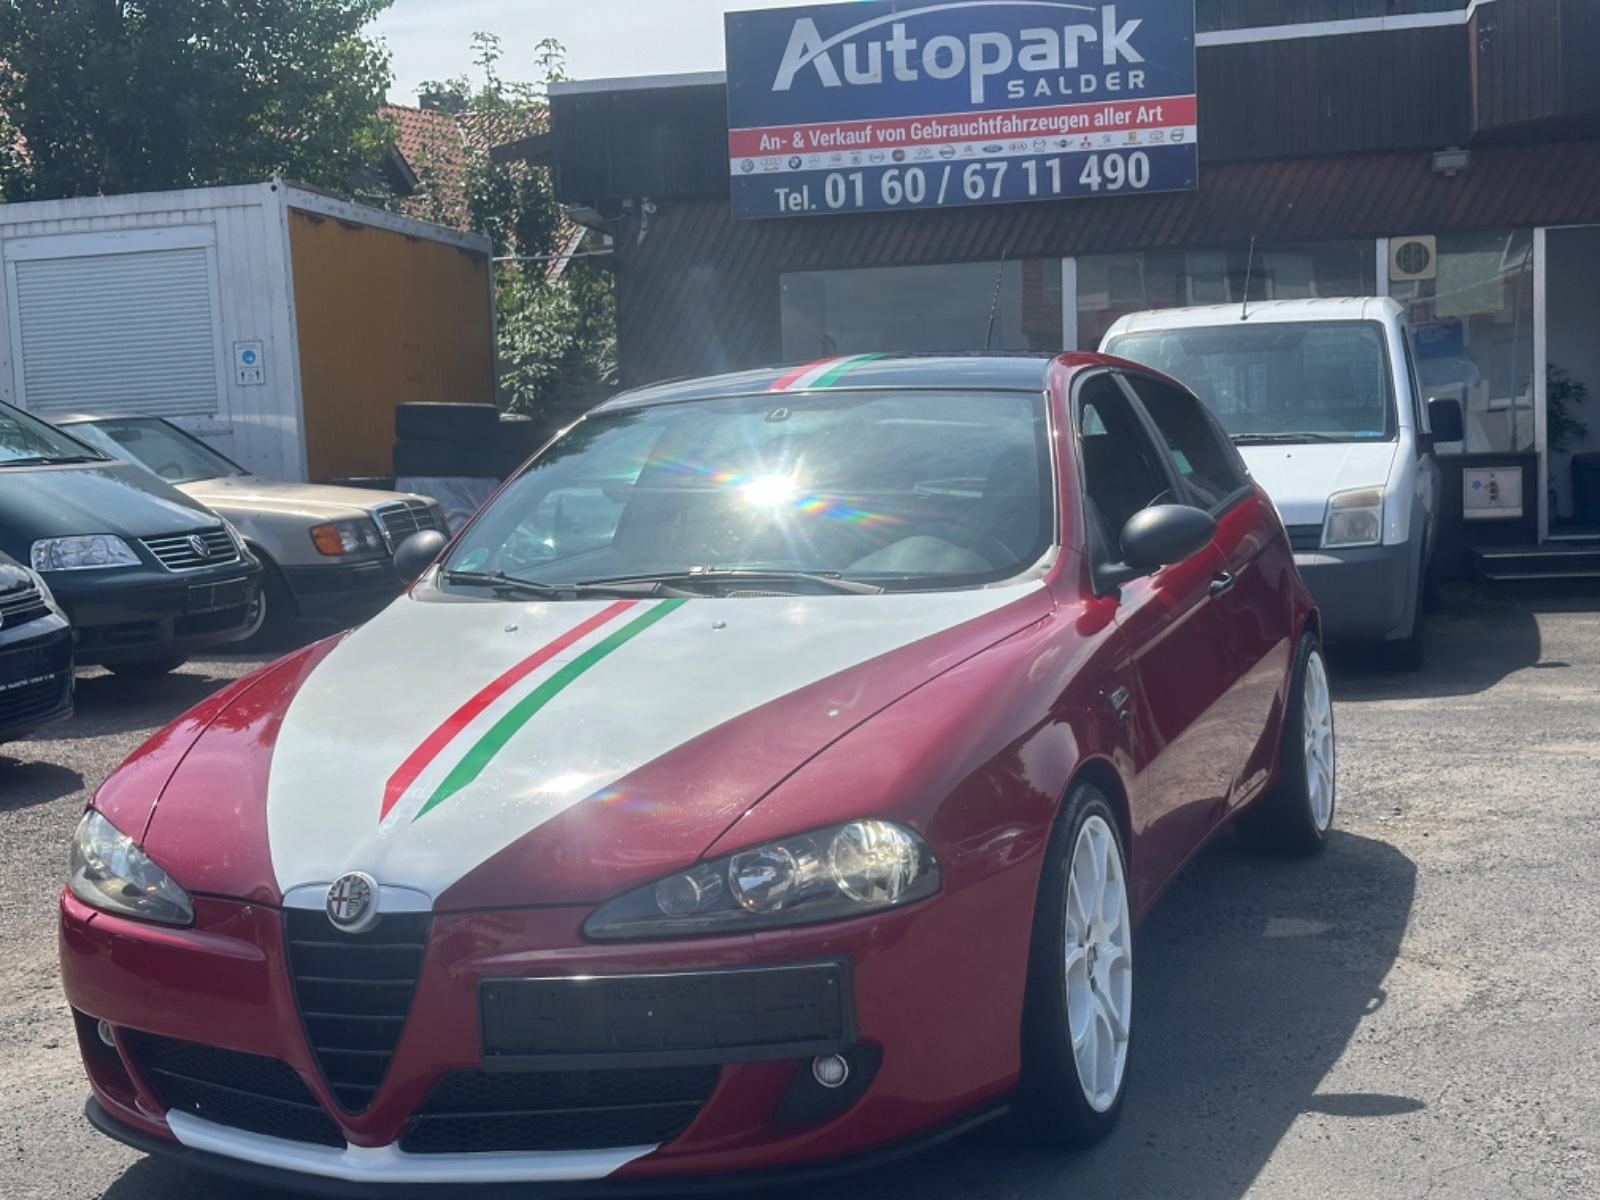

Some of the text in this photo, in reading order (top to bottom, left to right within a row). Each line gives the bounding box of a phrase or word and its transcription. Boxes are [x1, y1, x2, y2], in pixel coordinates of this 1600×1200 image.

[772, 4, 1145, 104] Autopark
[1007, 70, 1145, 99] SALDER
[759, 105, 1163, 151] An- & Verkauf von Gebrauchtfahrzeugen aller Art
[774, 151, 1150, 212] Tel. 01 60 / 67 11 490
